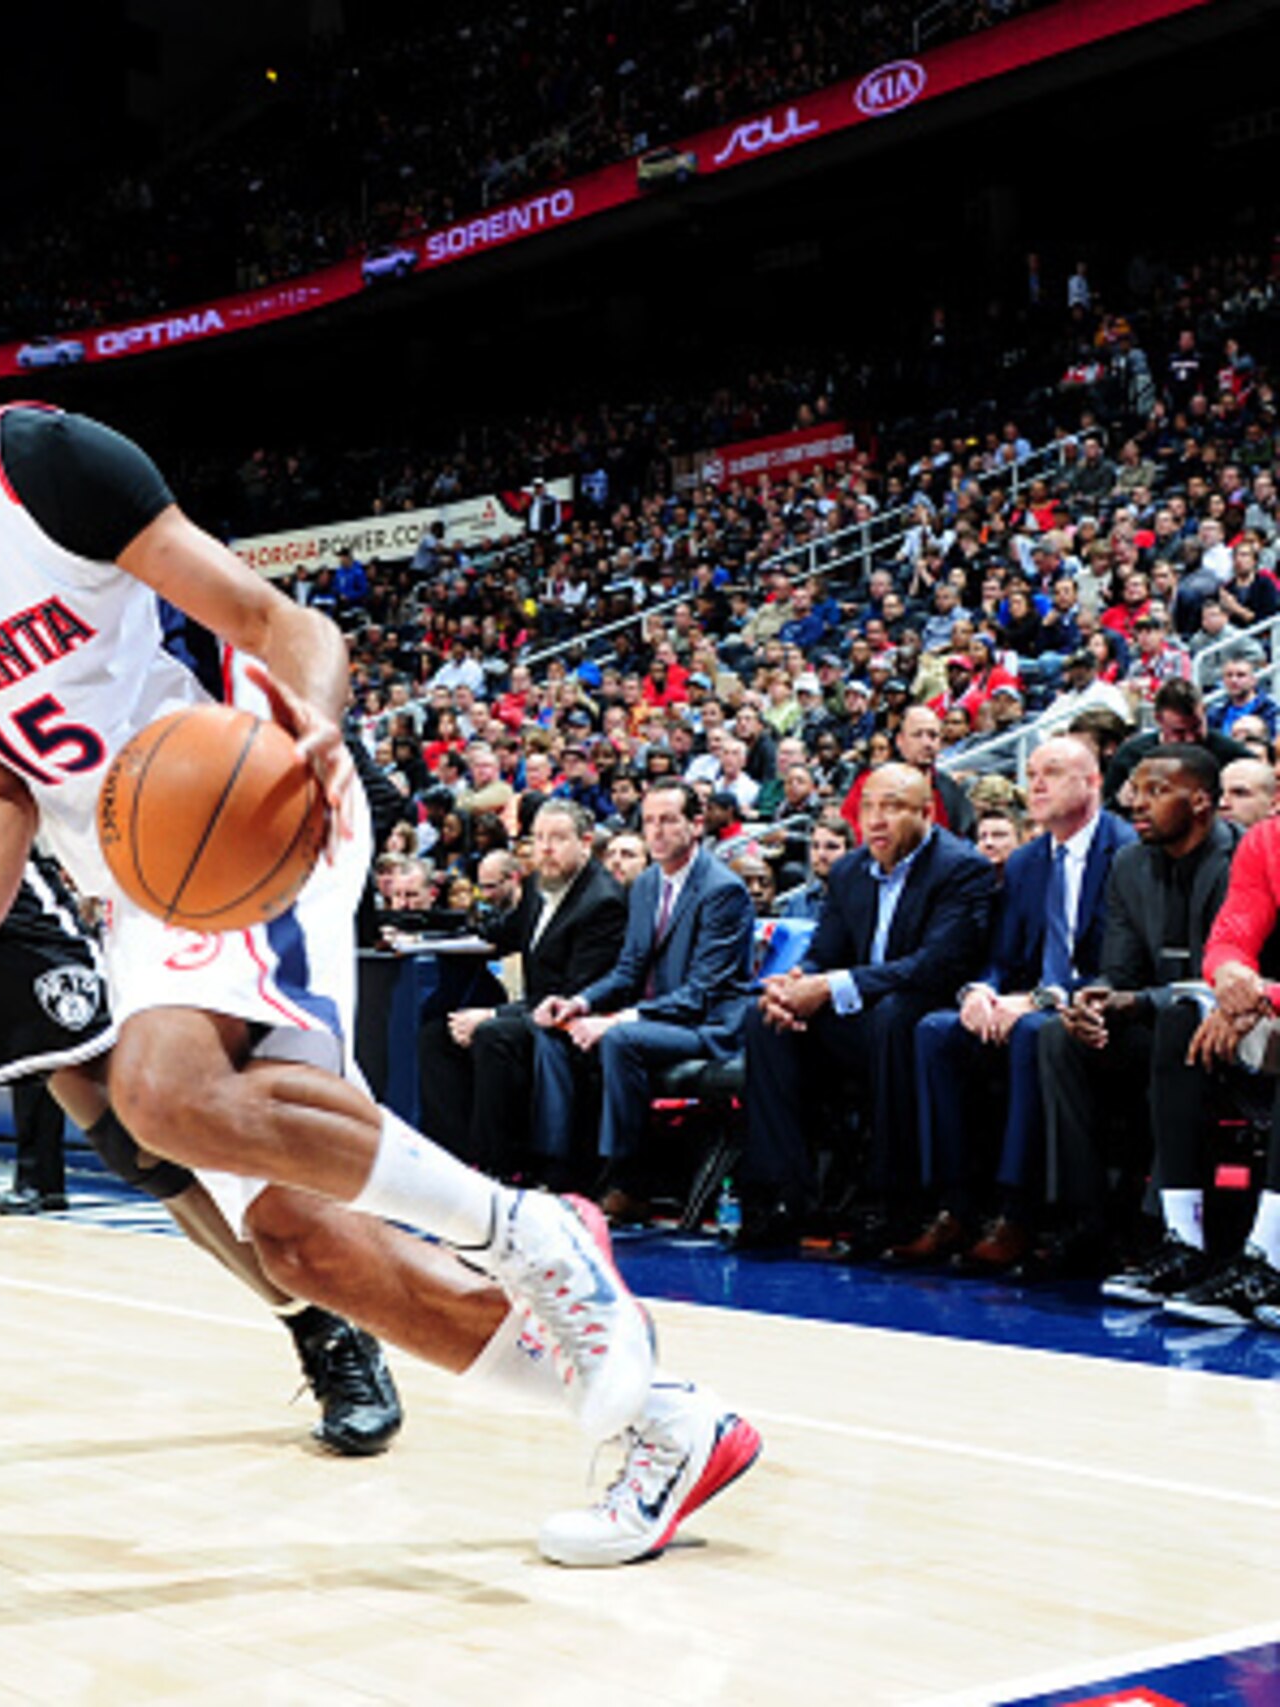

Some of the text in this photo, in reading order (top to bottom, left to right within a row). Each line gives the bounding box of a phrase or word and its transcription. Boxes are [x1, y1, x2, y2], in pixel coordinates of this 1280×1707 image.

[715, 108, 819, 164] SOUL
[426, 189, 574, 260] SORENTO
[96, 310, 224, 355] OPTIMA
